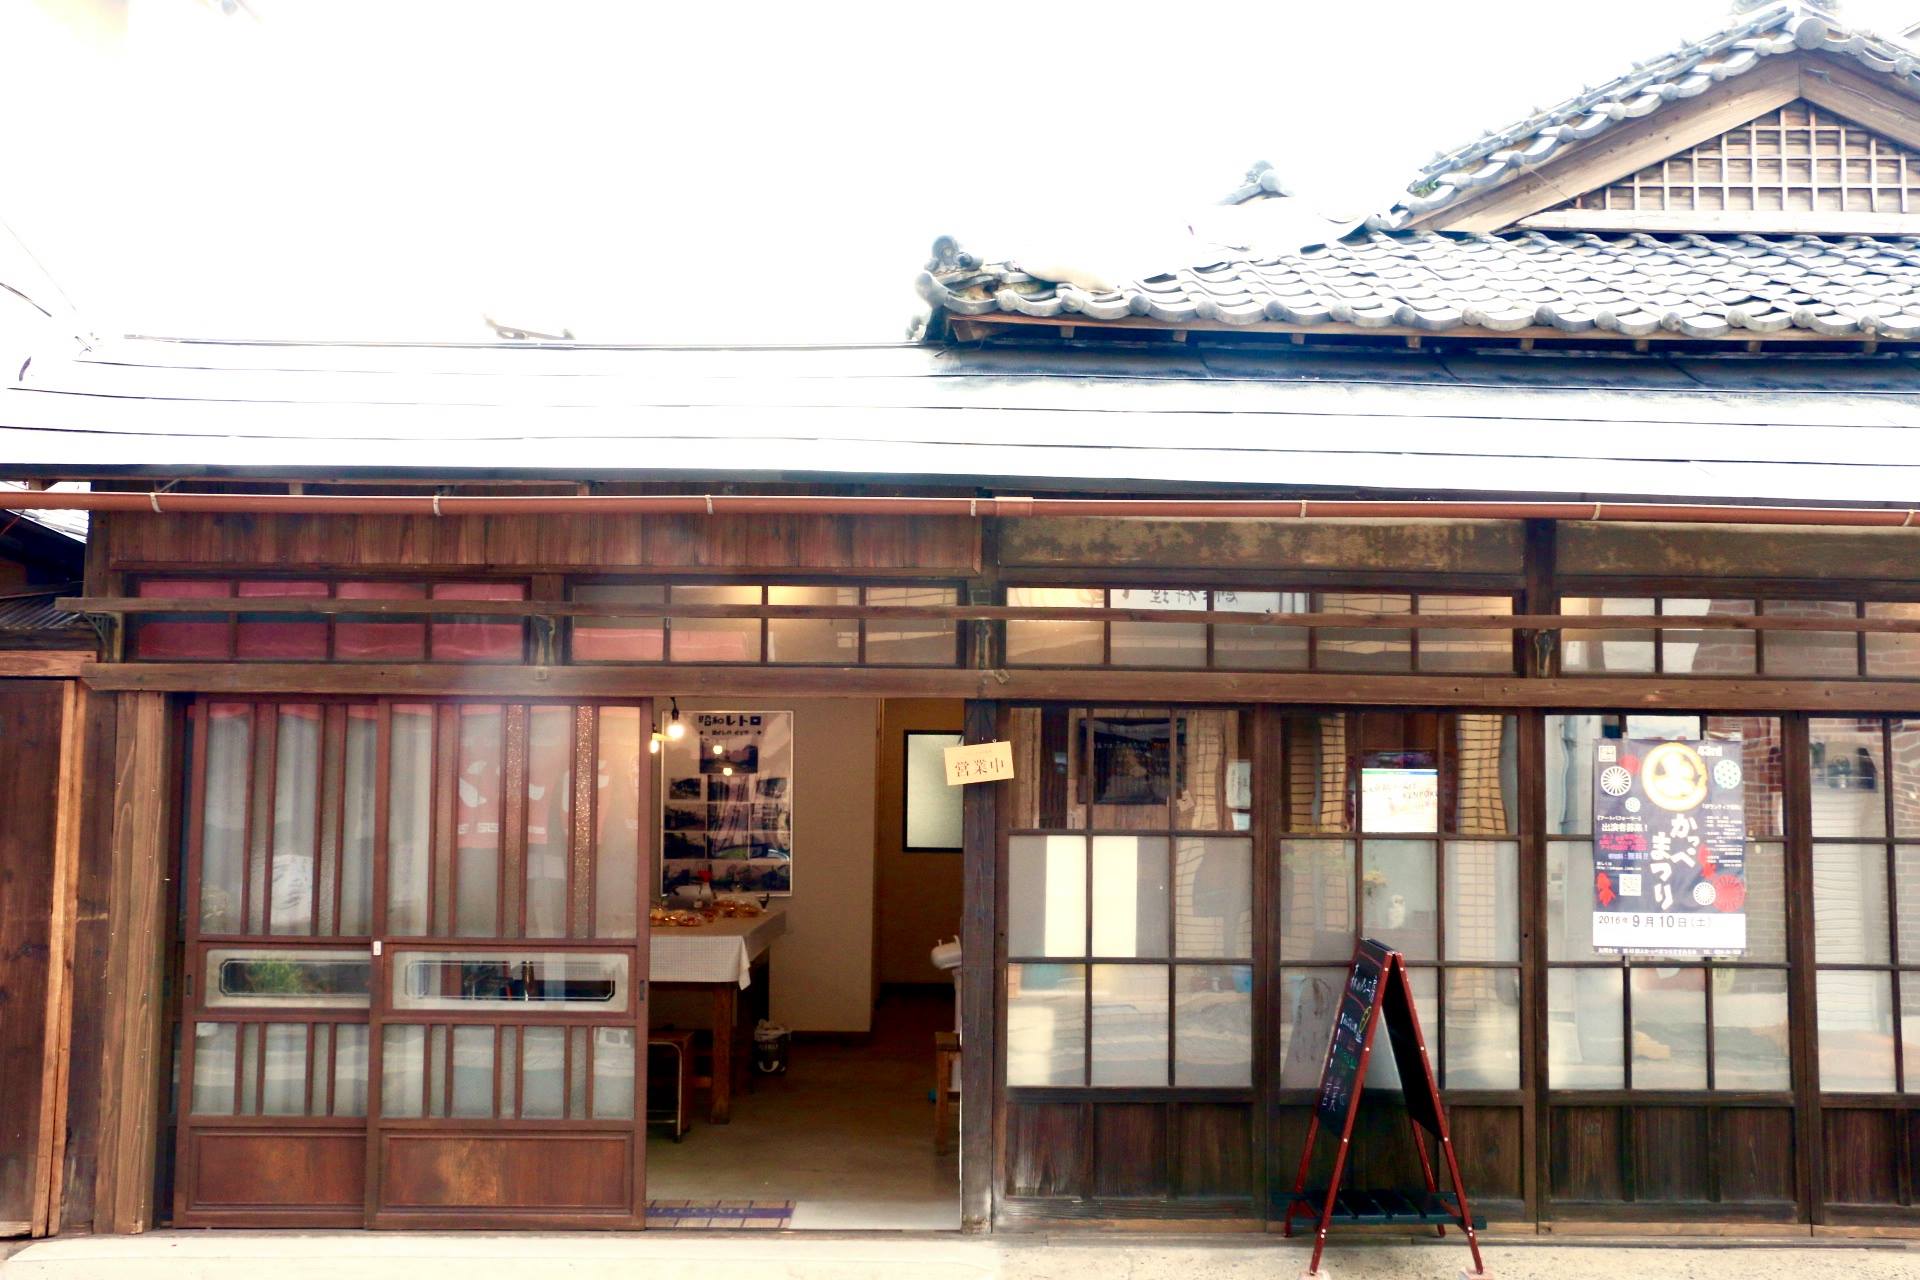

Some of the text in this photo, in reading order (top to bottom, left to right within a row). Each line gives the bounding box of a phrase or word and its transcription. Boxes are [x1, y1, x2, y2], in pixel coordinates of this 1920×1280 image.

[698, 714, 762, 727] 昭和レトロ
[954, 756, 1004, 778] 営業中
[1650, 831, 1674, 911] まつり
